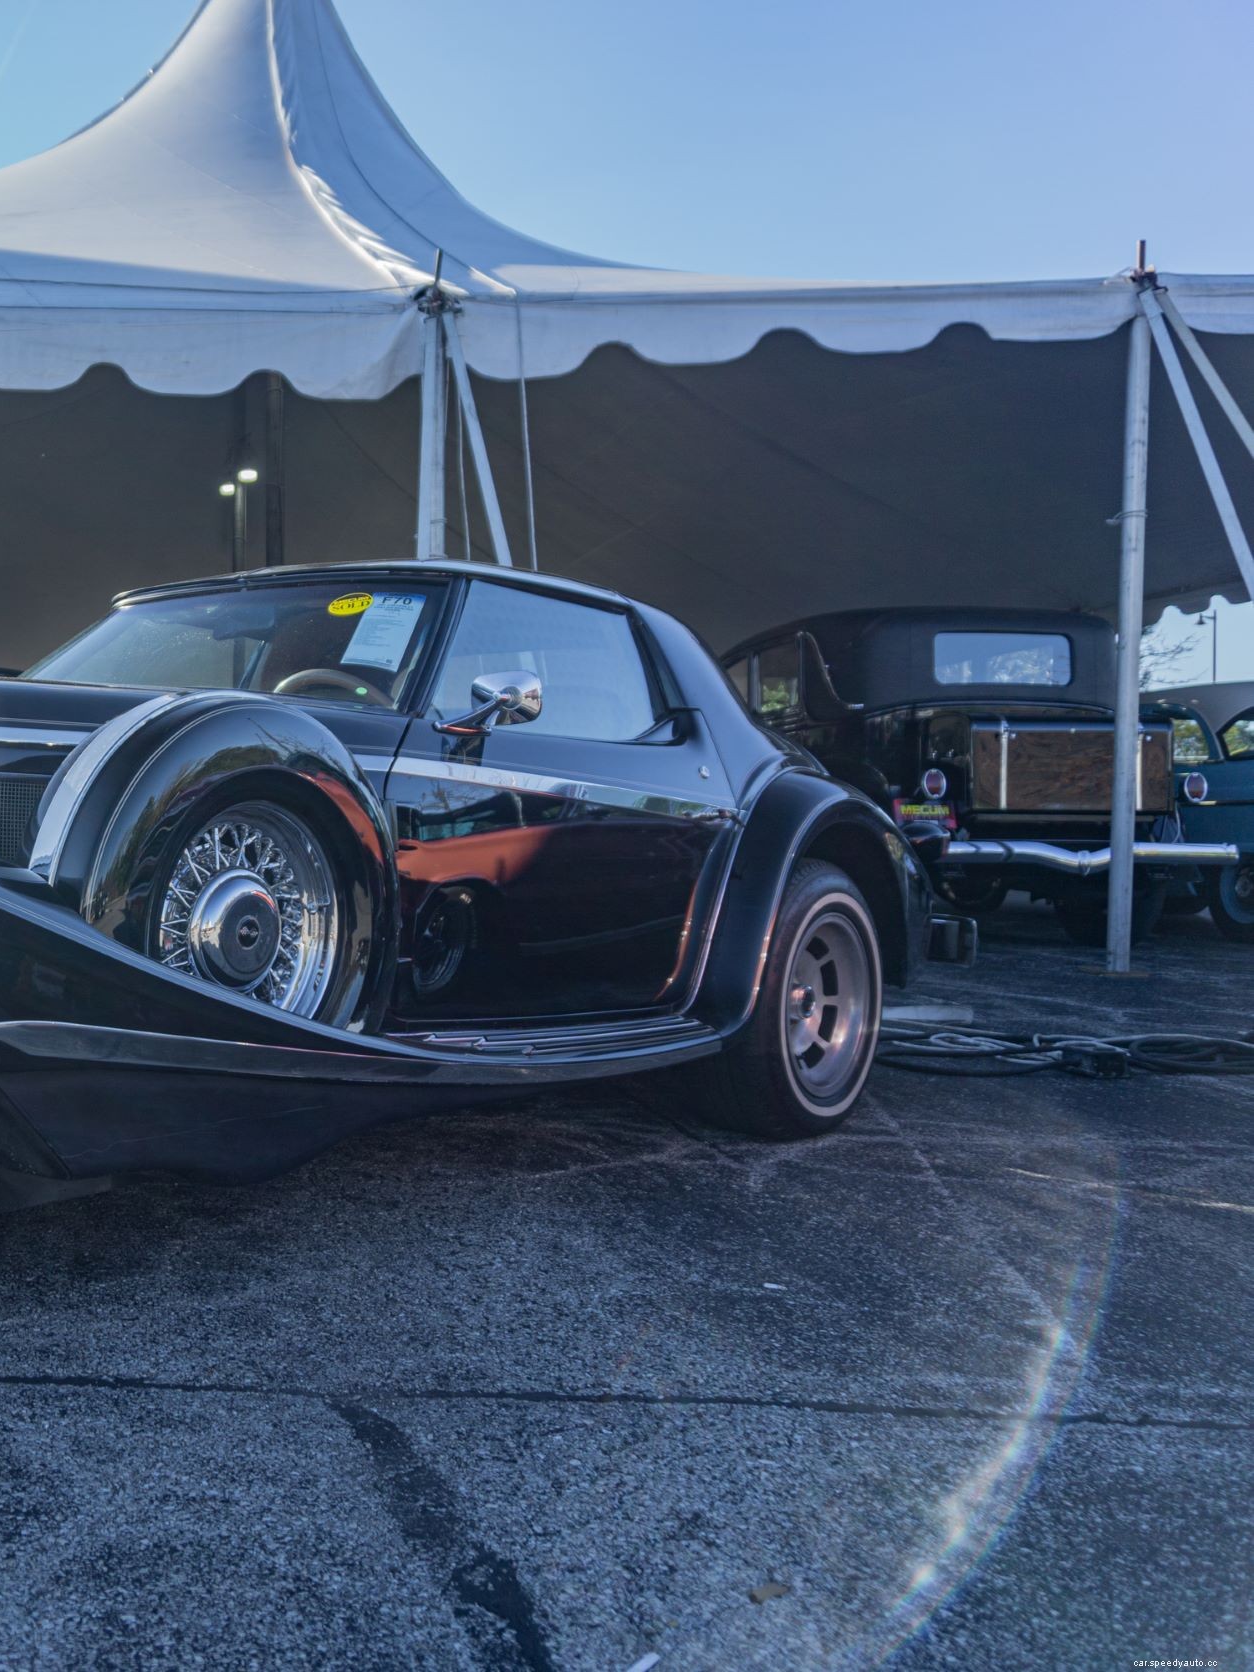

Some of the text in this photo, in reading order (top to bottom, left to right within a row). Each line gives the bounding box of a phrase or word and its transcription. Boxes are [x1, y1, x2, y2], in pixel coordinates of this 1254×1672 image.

[332, 600, 371, 610] SOLD
[382, 596, 412, 605] F70
[901, 804, 950, 815] MECUM
